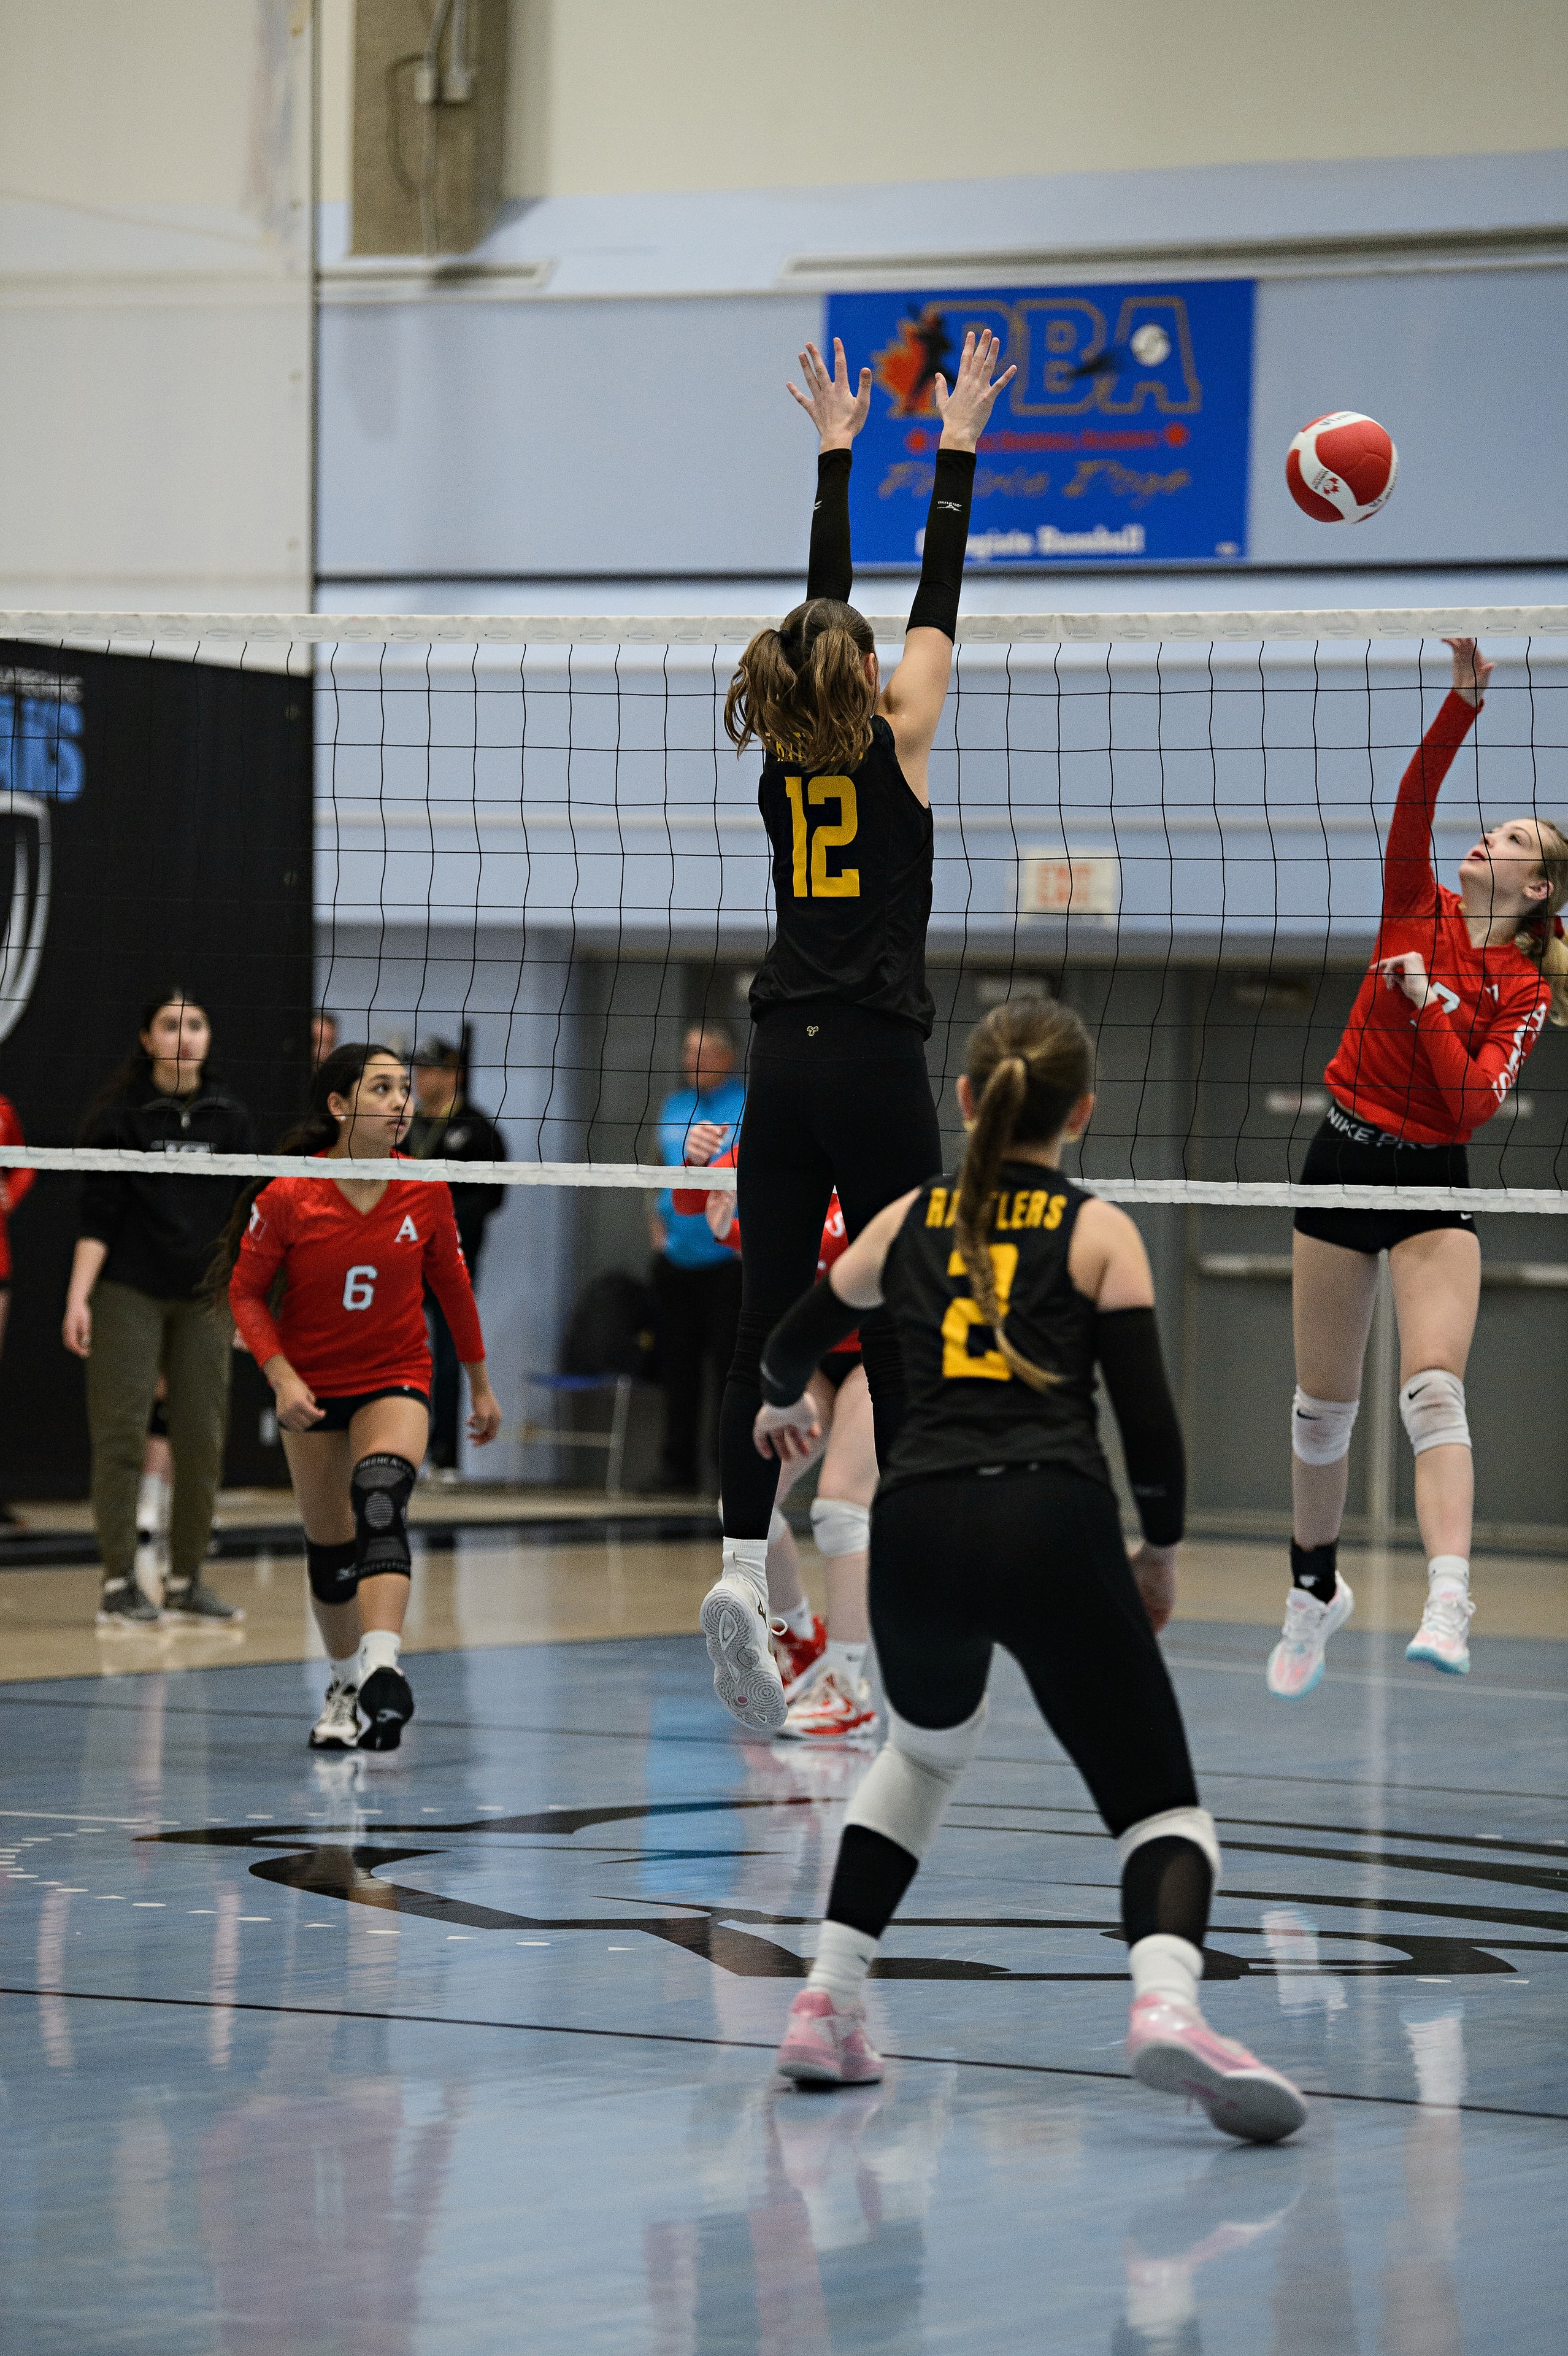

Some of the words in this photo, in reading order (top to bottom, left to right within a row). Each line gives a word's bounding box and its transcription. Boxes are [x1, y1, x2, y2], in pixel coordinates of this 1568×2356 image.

[785, 776, 860, 897] 12
[1326, 1106, 1376, 1145] NIKE
[394, 1214, 418, 1244] A
[925, 1187, 1067, 1231] RLERS
[342, 1265, 378, 1312] 6
[941, 1242, 1018, 1381] 2
